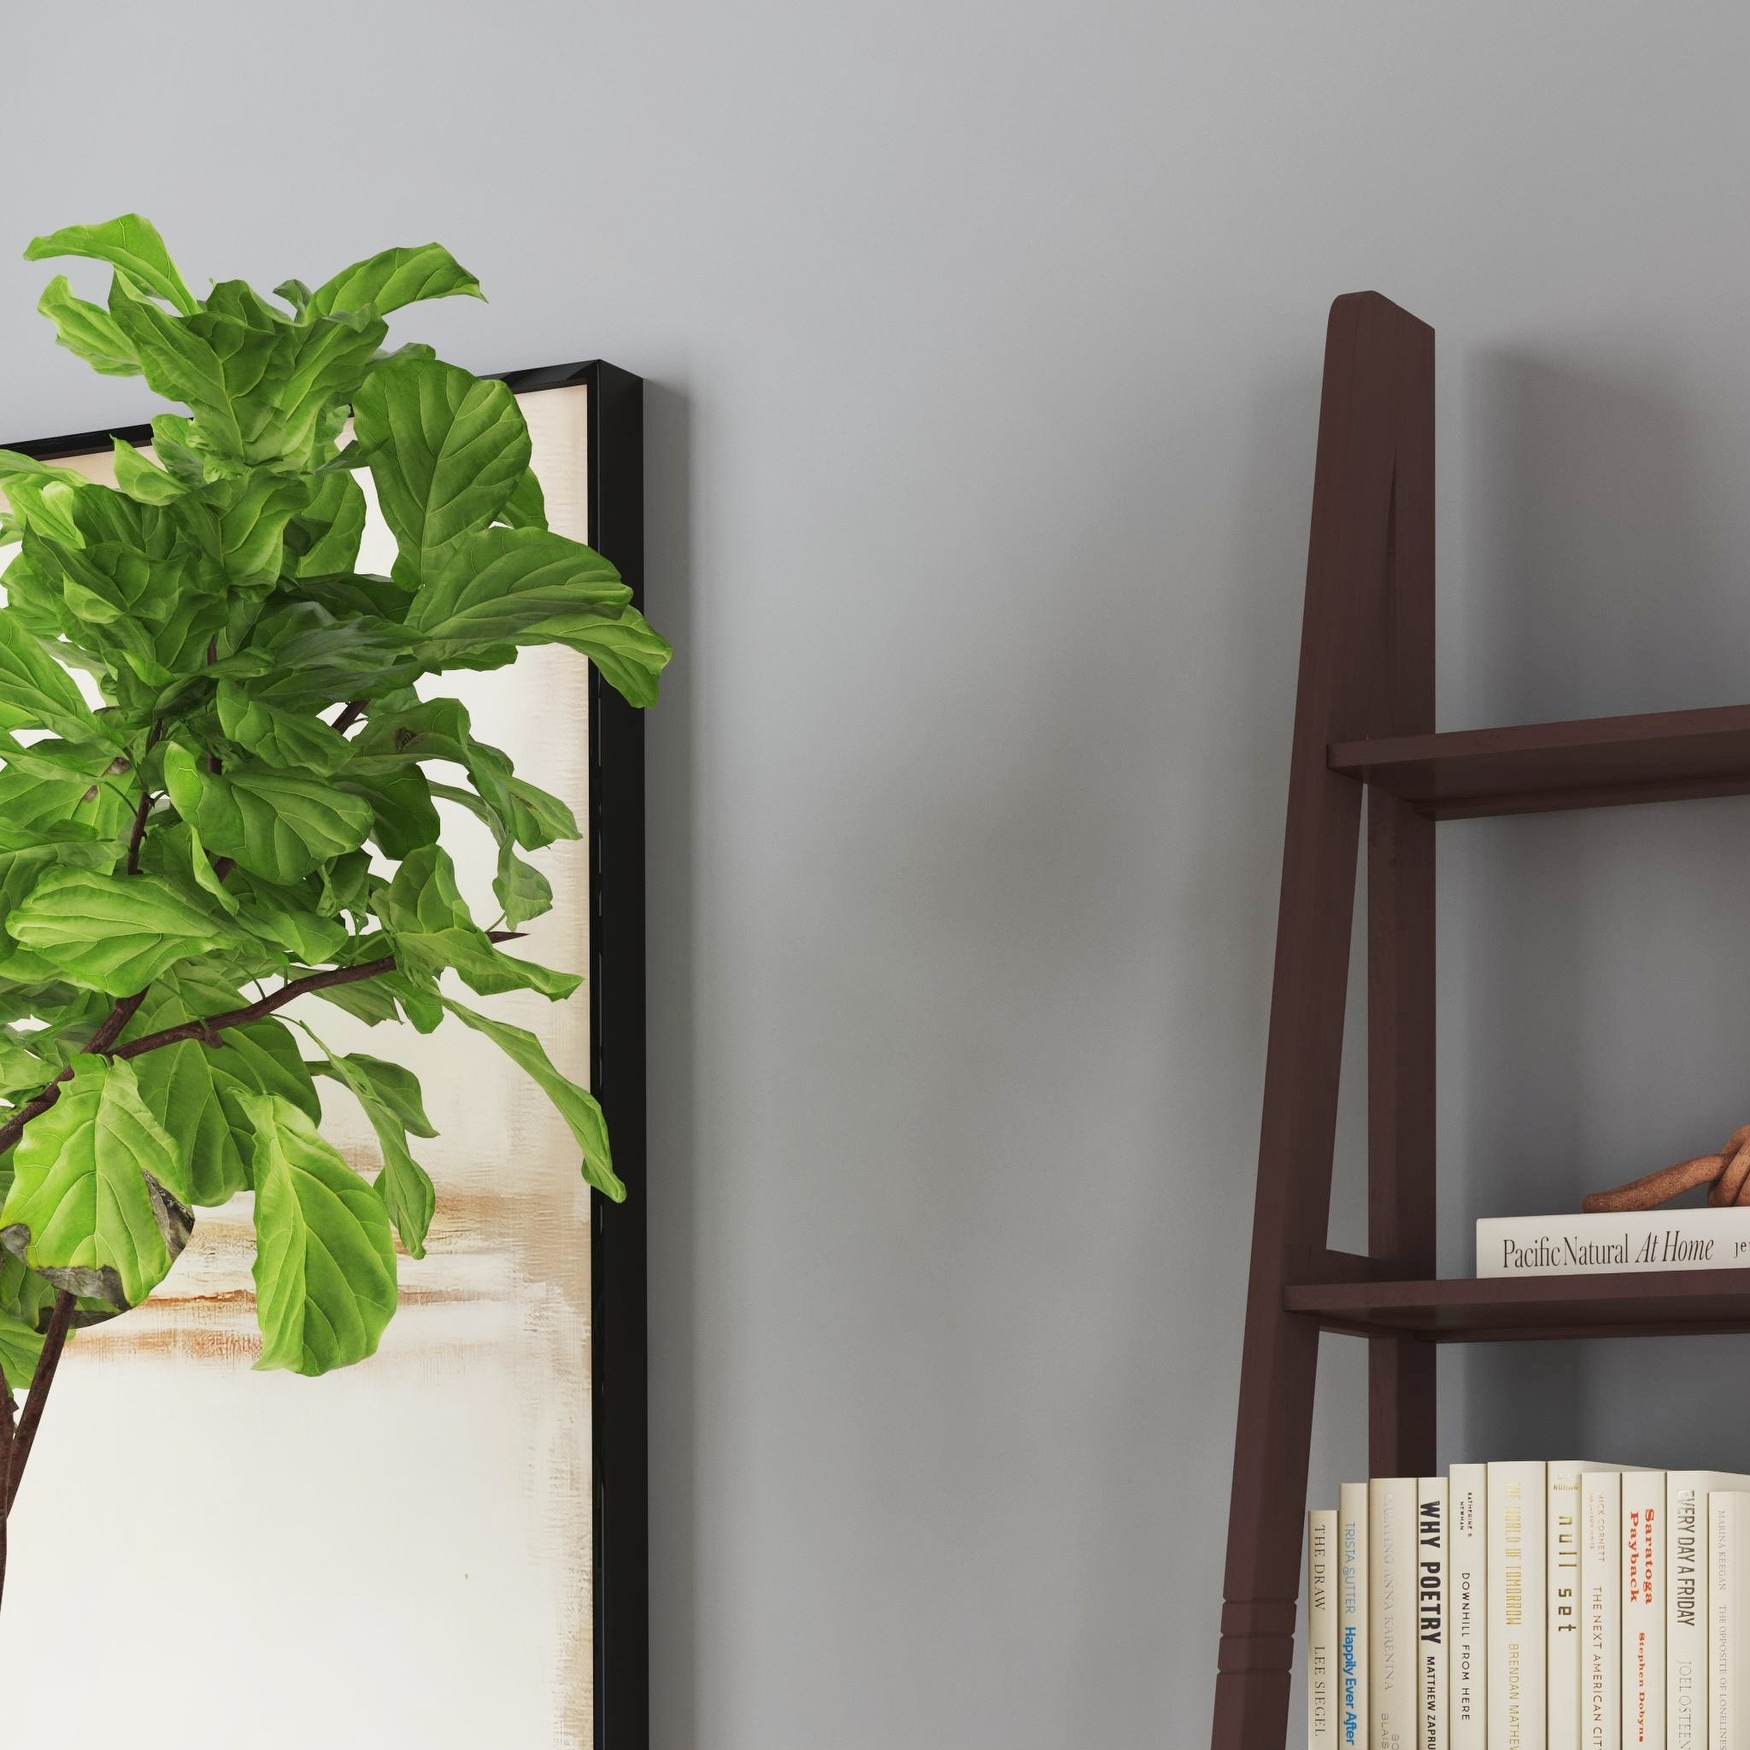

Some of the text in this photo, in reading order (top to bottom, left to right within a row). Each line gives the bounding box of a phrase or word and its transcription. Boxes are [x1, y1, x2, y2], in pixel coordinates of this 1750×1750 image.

[1503, 1230, 1714, 1269] Pacific Natural At Home
[1314, 1524, 1326, 1611] THE DRAW
[1342, 1522, 1356, 1614] TRISTA SUTTER
[1383, 1569, 1394, 1611] ANNA
[1420, 1501, 1441, 1645] WHY POETRY
[1558, 1515, 1577, 1632] null set
[1629, 1511, 1640, 1603] Payback
[1642, 1508, 1655, 1605] Saratoga
[1677, 1489, 1695, 1627] EVERY DAY A FRIDAY
[1718, 1510, 1726, 1591] MARINA KEEGAN
[1505, 1565, 1521, 1626] TOMORROW
[1592, 1586, 1603, 1611] THE
[1592, 1615, 1603, 1649] NEXT
[1719, 1605, 1727, 1624] THE
[1343, 1626, 1357, 1745] Happily Ever After
[1383, 1616, 1394, 1690] KARENINA
[1426, 1656, 1437, 1711] MATTHEW
[1461, 1572, 1470, 1721] DOWNHILL FROM HERE
[1509, 1643, 1520, 1700] BRENDAN
[1719, 1626, 1727, 1675] OPPOSITE
[1719, 1677, 1727, 1692] OF
[1314, 1646, 1326, 1737] LEE SIEGEL
[1592, 1653, 1603, 1722] AMERICAN
[1637, 1632, 1646, 1743] Stephen Dobyns
[1677, 1660, 1692, 1750] JOEL OSTEEN
